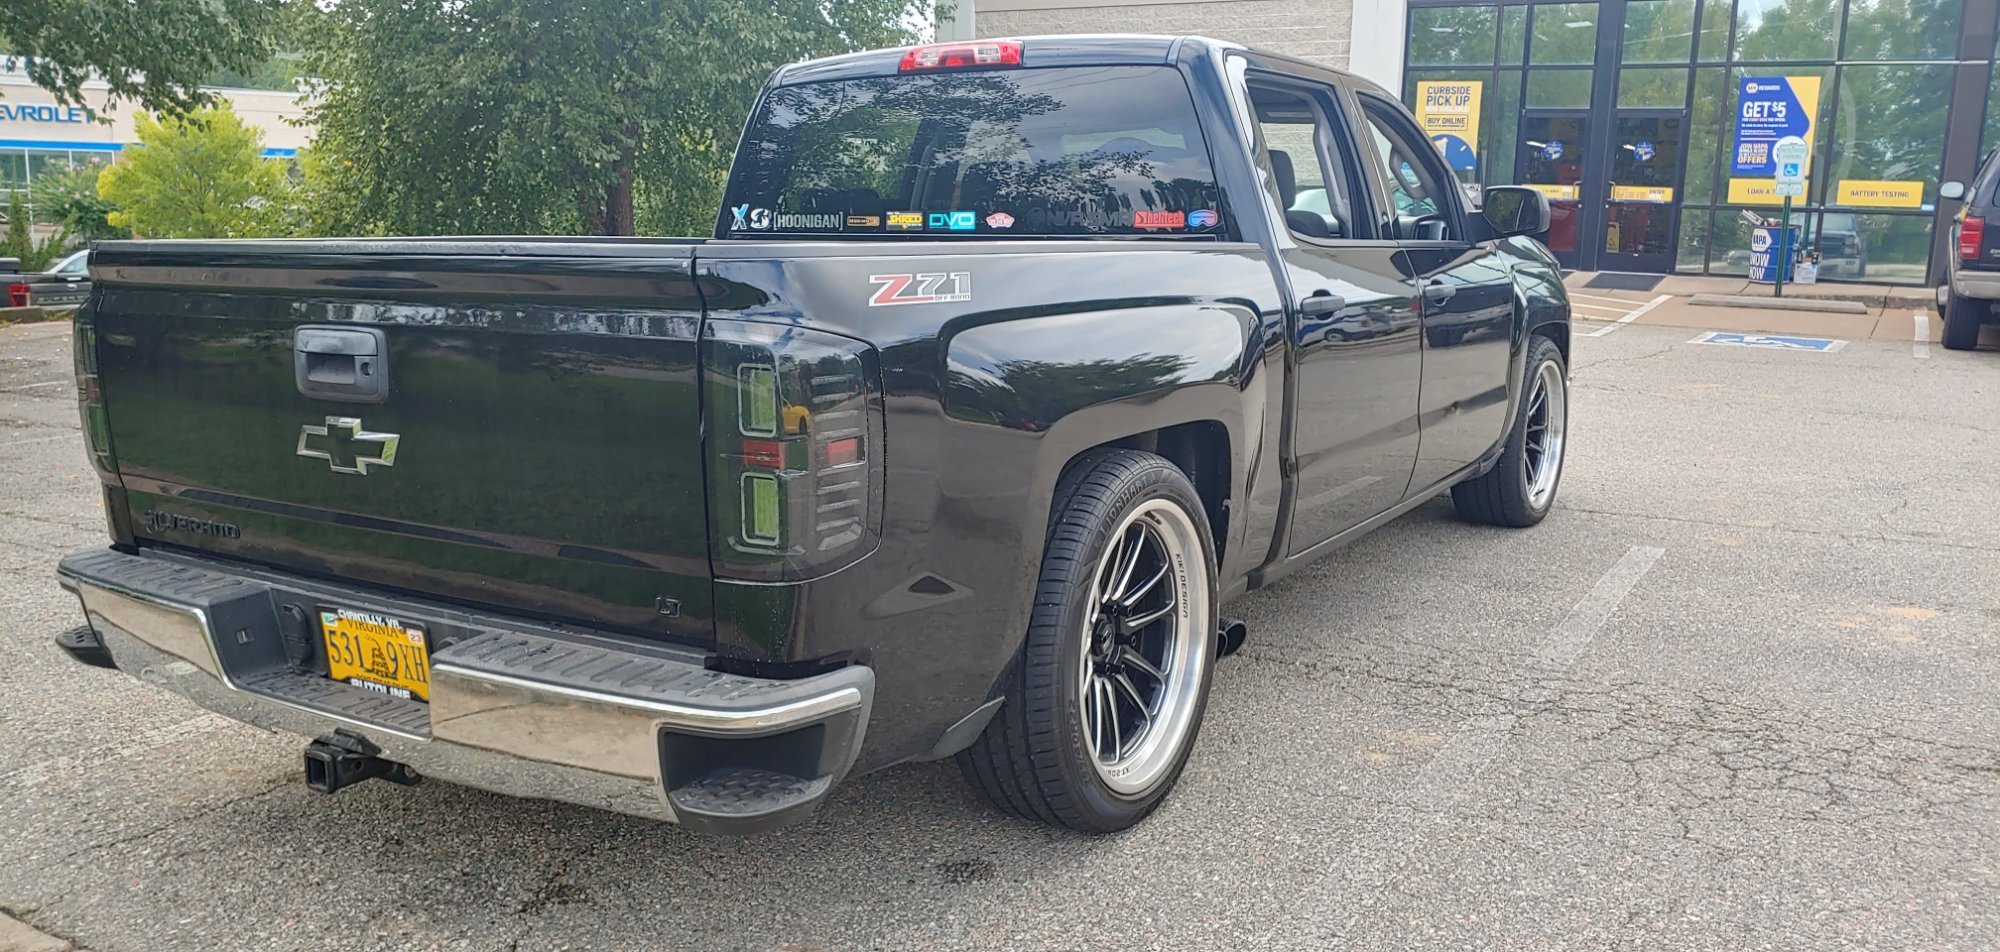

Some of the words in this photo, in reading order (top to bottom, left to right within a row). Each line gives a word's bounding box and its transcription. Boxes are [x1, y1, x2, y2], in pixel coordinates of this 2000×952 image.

[1427, 86, 1471, 95] CURBSIDE
[1426, 95, 1452, 106] PICK
[1455, 95, 1470, 106] UP
[1743, 101, 1771, 118] GET
[1772, 101, 1787, 118] $5
[1738, 156, 1767, 164] OFFERS
[1882, 190, 1909, 198] TESTING
[929, 213, 974, 226] DVO
[869, 272, 971, 306] Z71
[345, 617, 399, 638] VIRGINIA
[328, 629, 364, 669] 531
